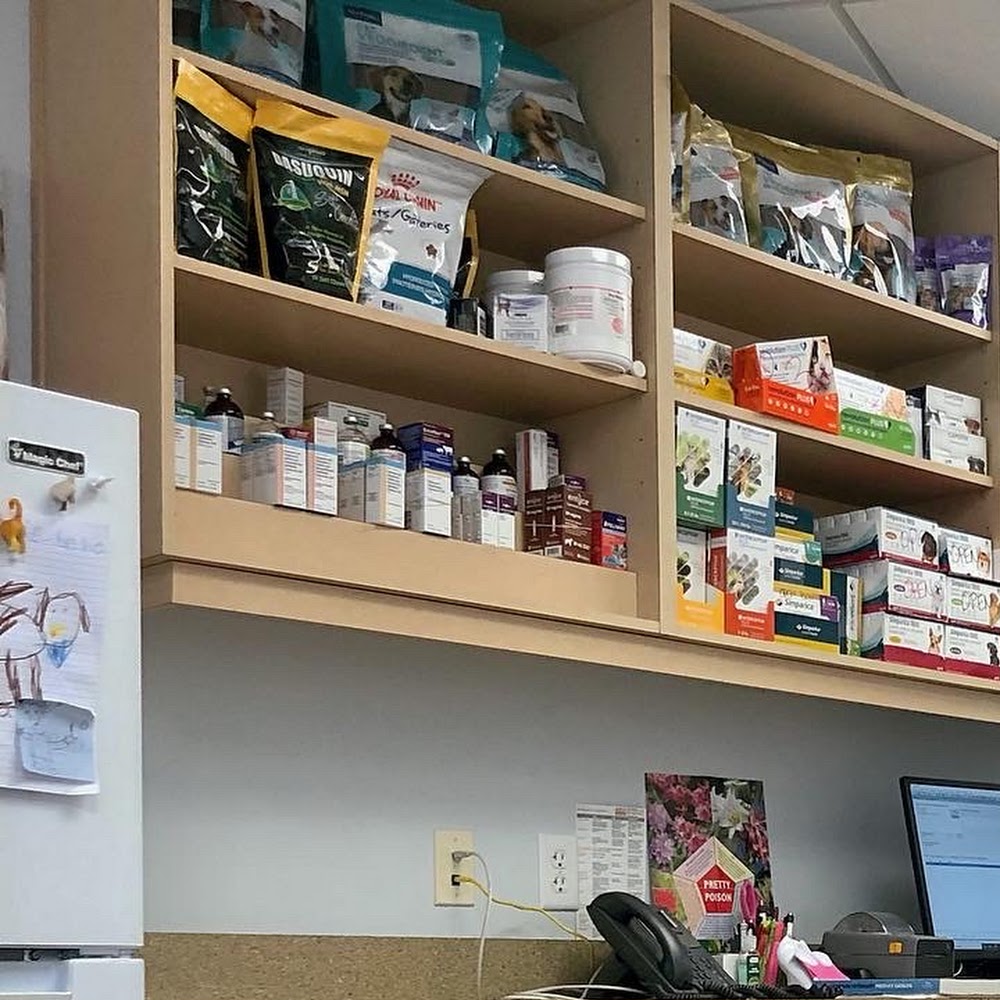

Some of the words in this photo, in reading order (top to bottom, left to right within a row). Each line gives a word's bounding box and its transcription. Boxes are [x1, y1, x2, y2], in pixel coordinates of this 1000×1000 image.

[271, 151, 353, 187] DASUQUIN
[375, 186, 401, 201] OYAL
[22, 450, 55, 466] Magic
[56, 457, 80, 471] Chef
[783, 598, 815, 612] Simparica
[703, 880, 731, 889] PRETTY
[704, 893, 732, 902] POISON
